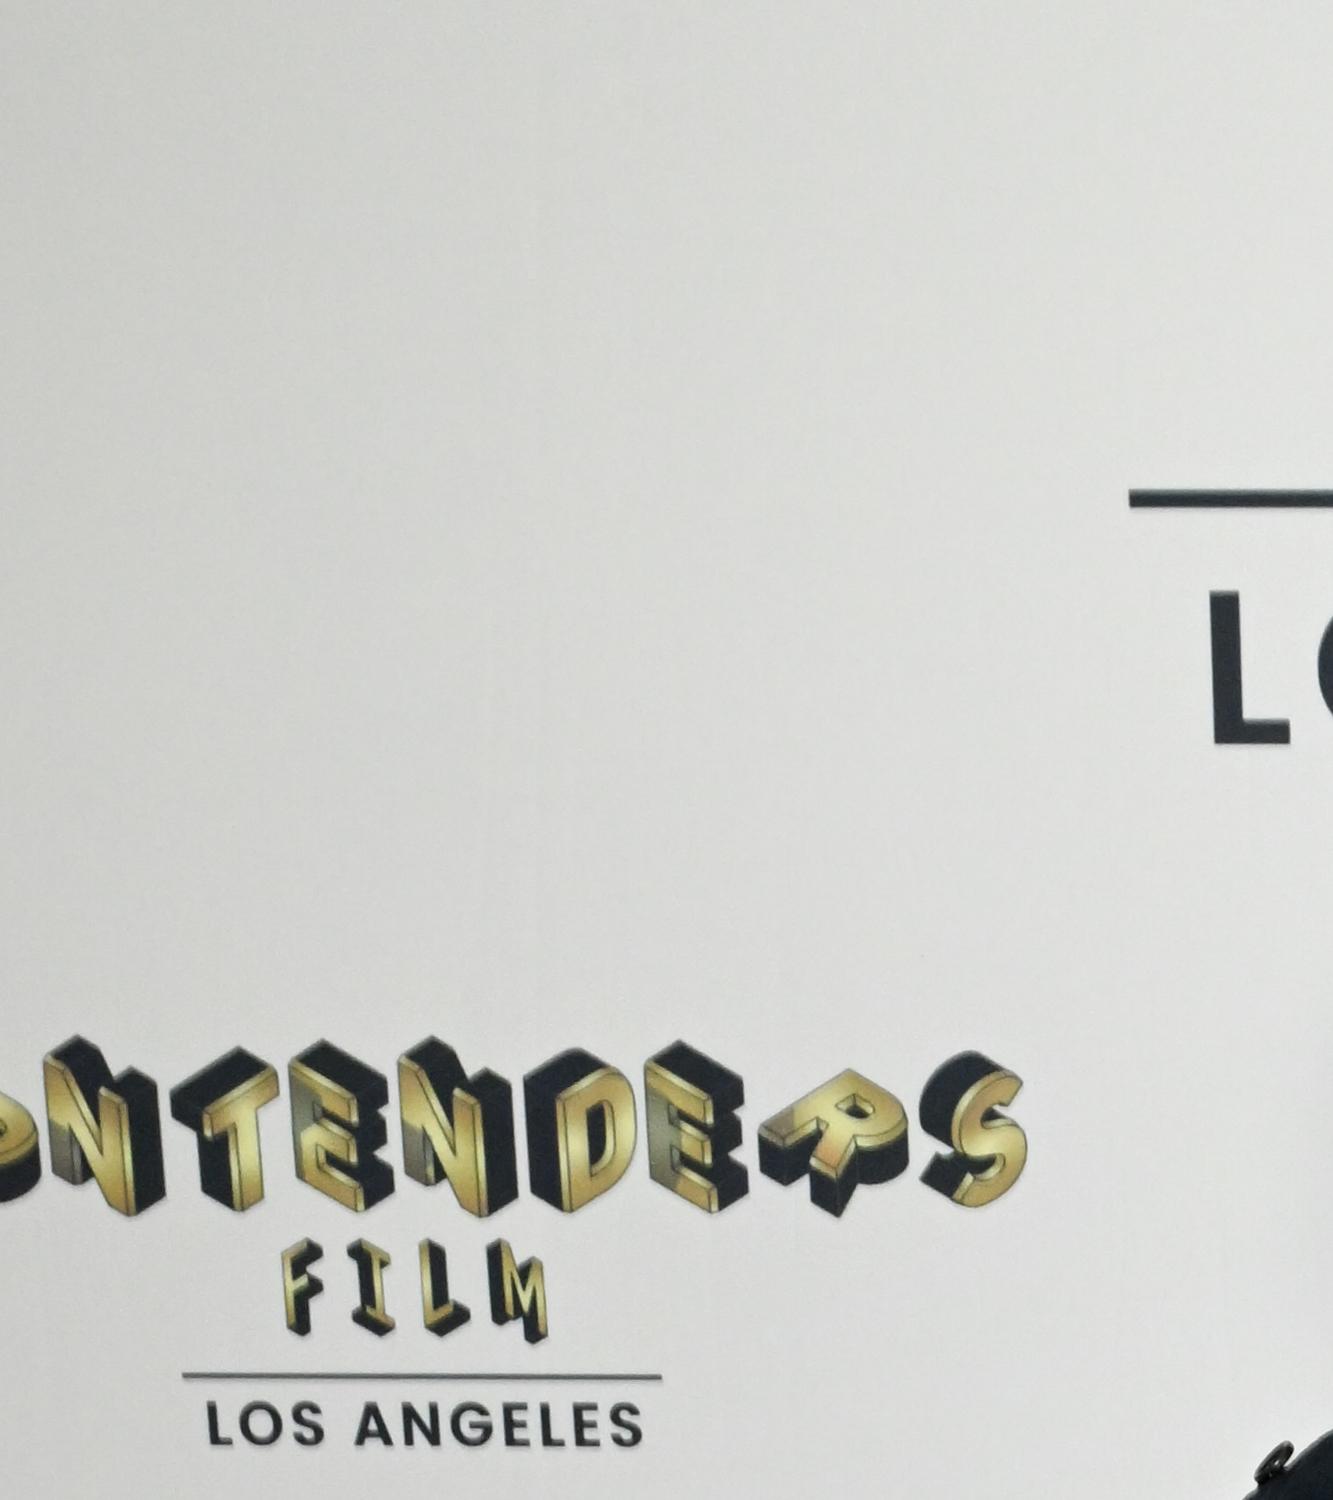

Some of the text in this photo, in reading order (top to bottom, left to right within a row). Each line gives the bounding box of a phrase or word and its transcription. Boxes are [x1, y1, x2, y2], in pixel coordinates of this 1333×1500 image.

[281, 1237, 549, 1346] FILM
[206, 1401, 645, 1449] LOS ANGELES
